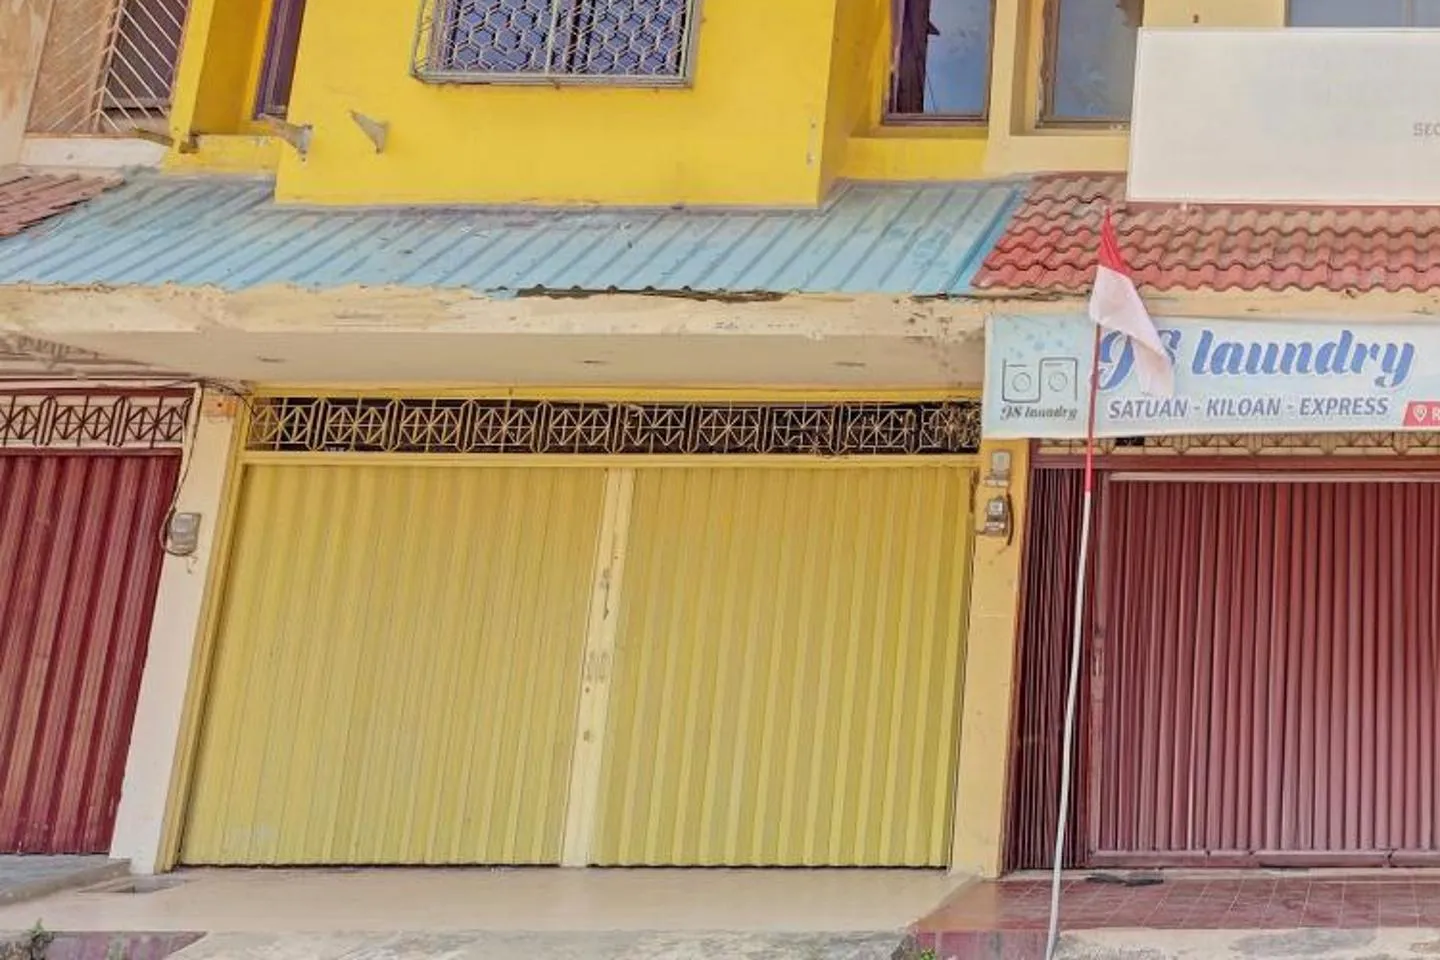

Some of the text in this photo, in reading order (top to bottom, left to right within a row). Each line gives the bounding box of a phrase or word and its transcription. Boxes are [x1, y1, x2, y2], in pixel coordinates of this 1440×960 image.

[1192, 329, 1415, 388] laundry
[1024, 404, 1078, 421] laundry
[1108, 396, 1389, 419] SATUAN KILOAN EXPRESS
